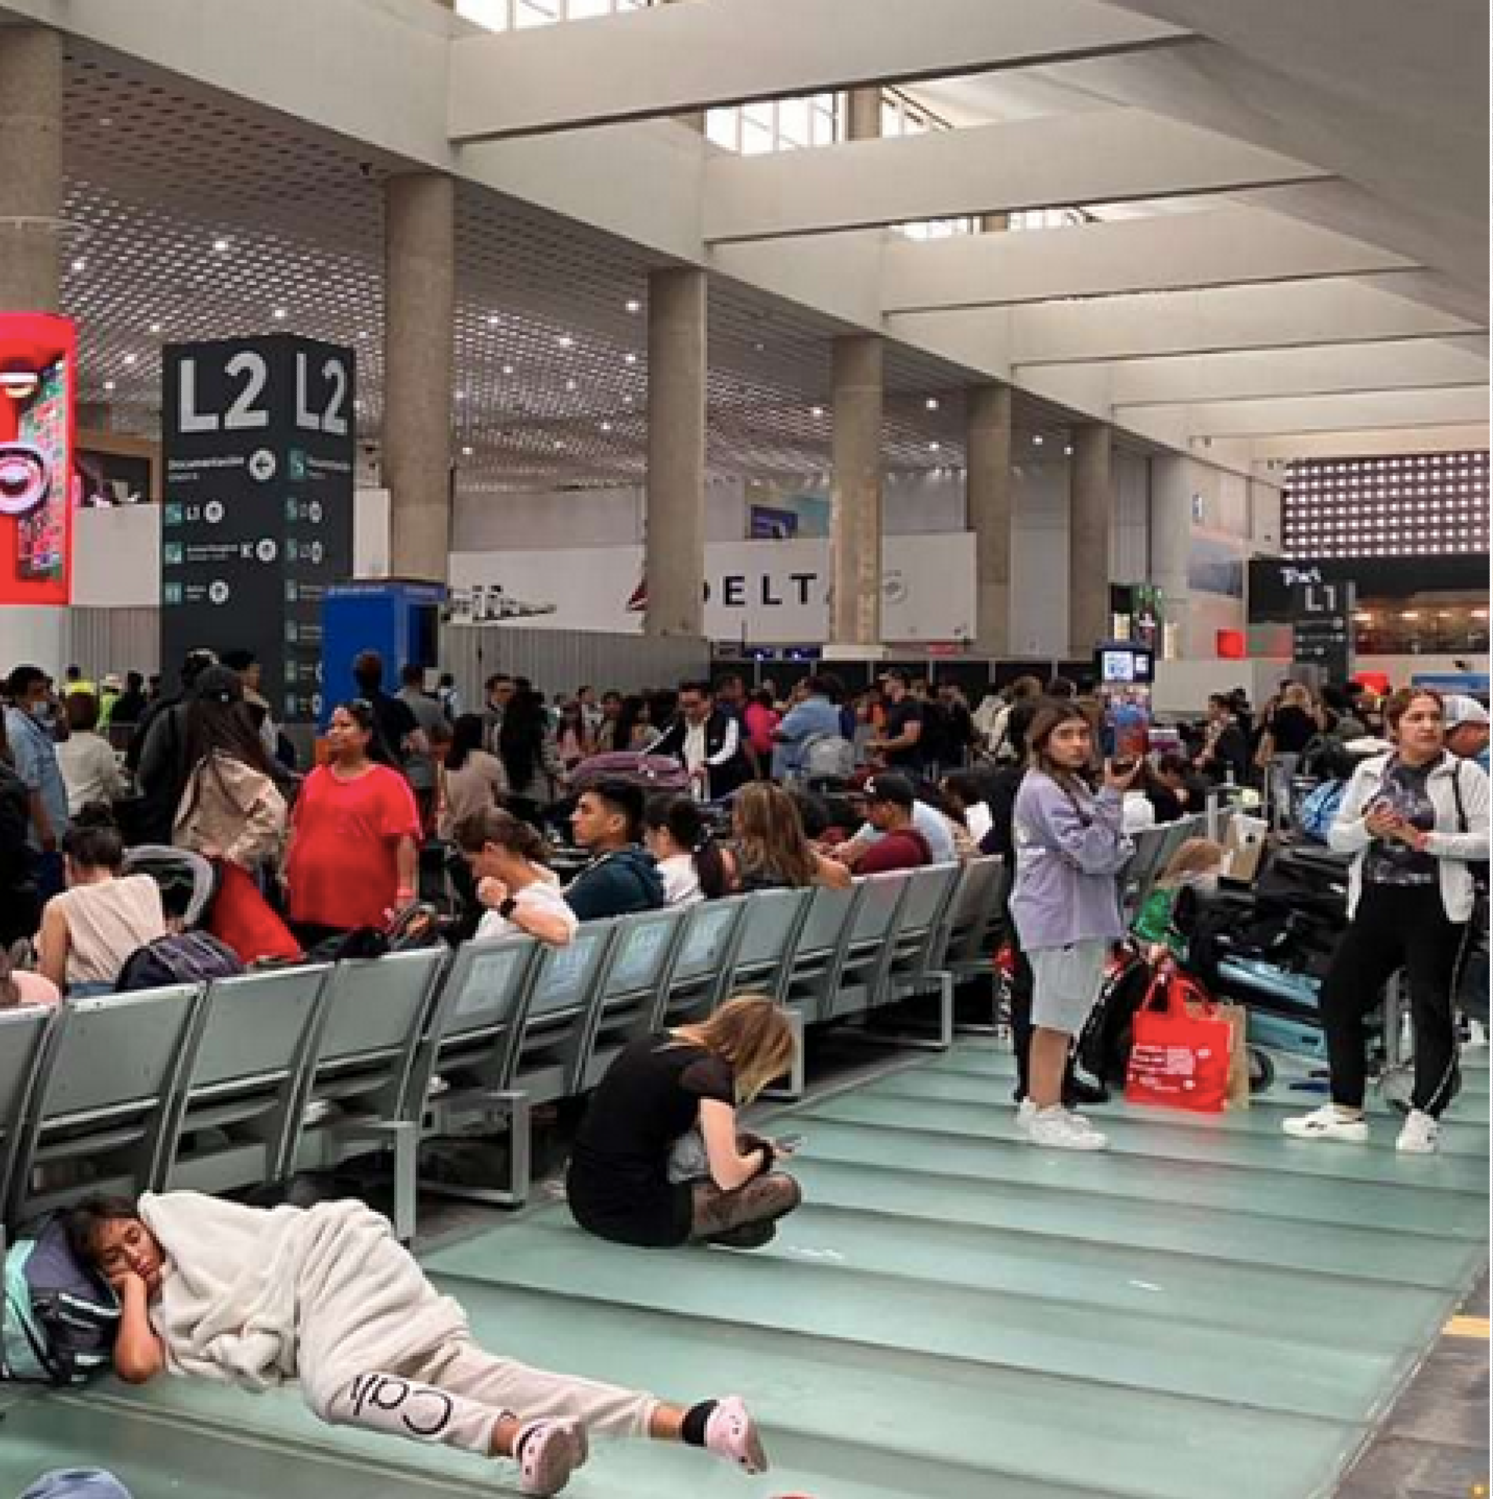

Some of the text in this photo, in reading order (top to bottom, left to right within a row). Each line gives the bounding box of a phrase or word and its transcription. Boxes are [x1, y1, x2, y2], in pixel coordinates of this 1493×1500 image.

[179, 352, 269, 433] L2
[295, 352, 348, 436] L2
[703, 572, 830, 605] ELT
[1305, 585, 1336, 611] L1
